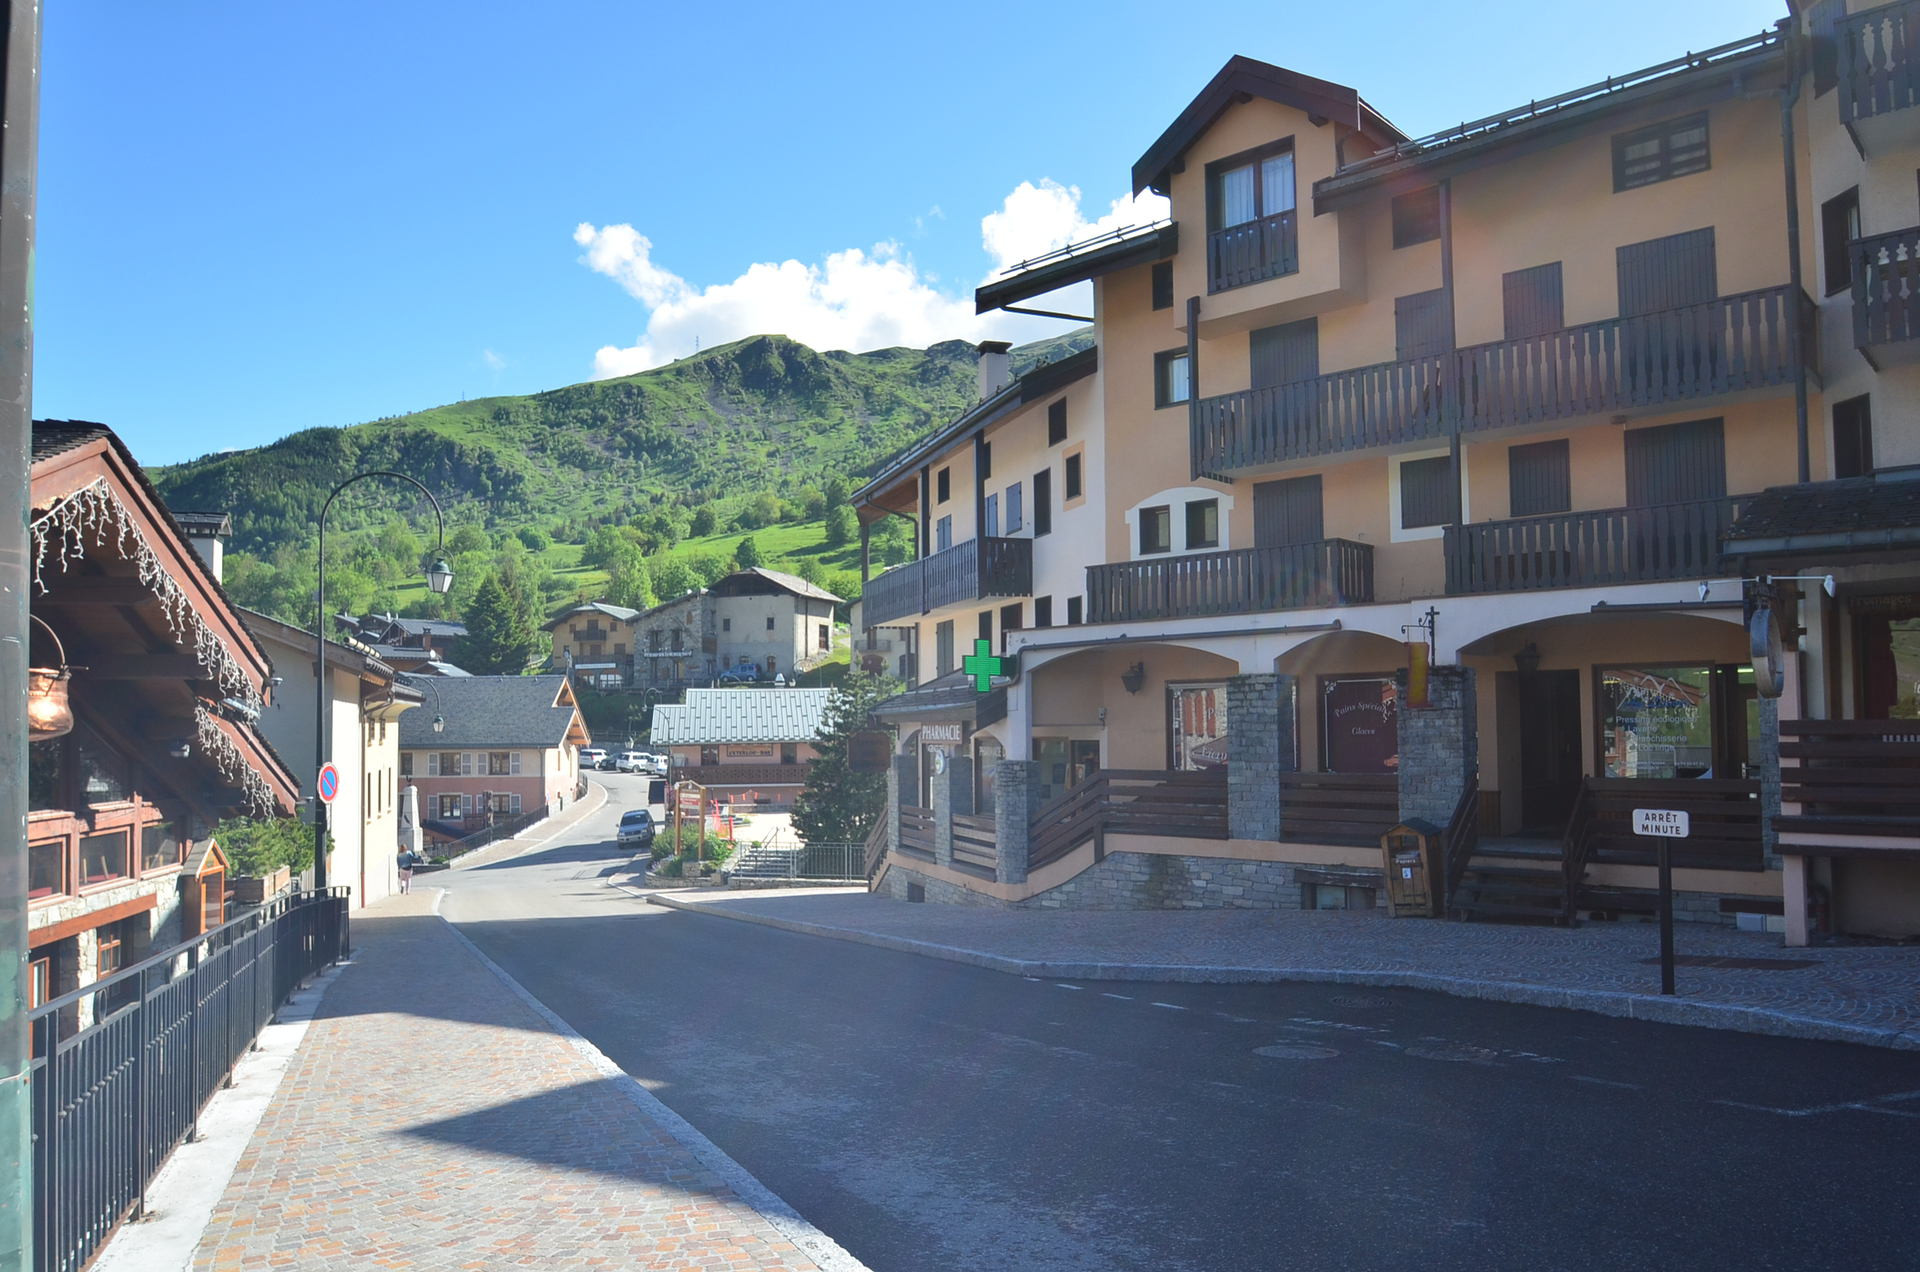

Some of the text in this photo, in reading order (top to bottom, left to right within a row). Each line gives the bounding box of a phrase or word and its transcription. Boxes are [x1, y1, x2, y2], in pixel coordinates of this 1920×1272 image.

[1616, 715, 1650, 725] Pressing
[921, 724, 961, 741] PHARMACIE
[1644, 811, 1678, 823] ARRÊT
[1641, 824, 1681, 835] MINUTE
